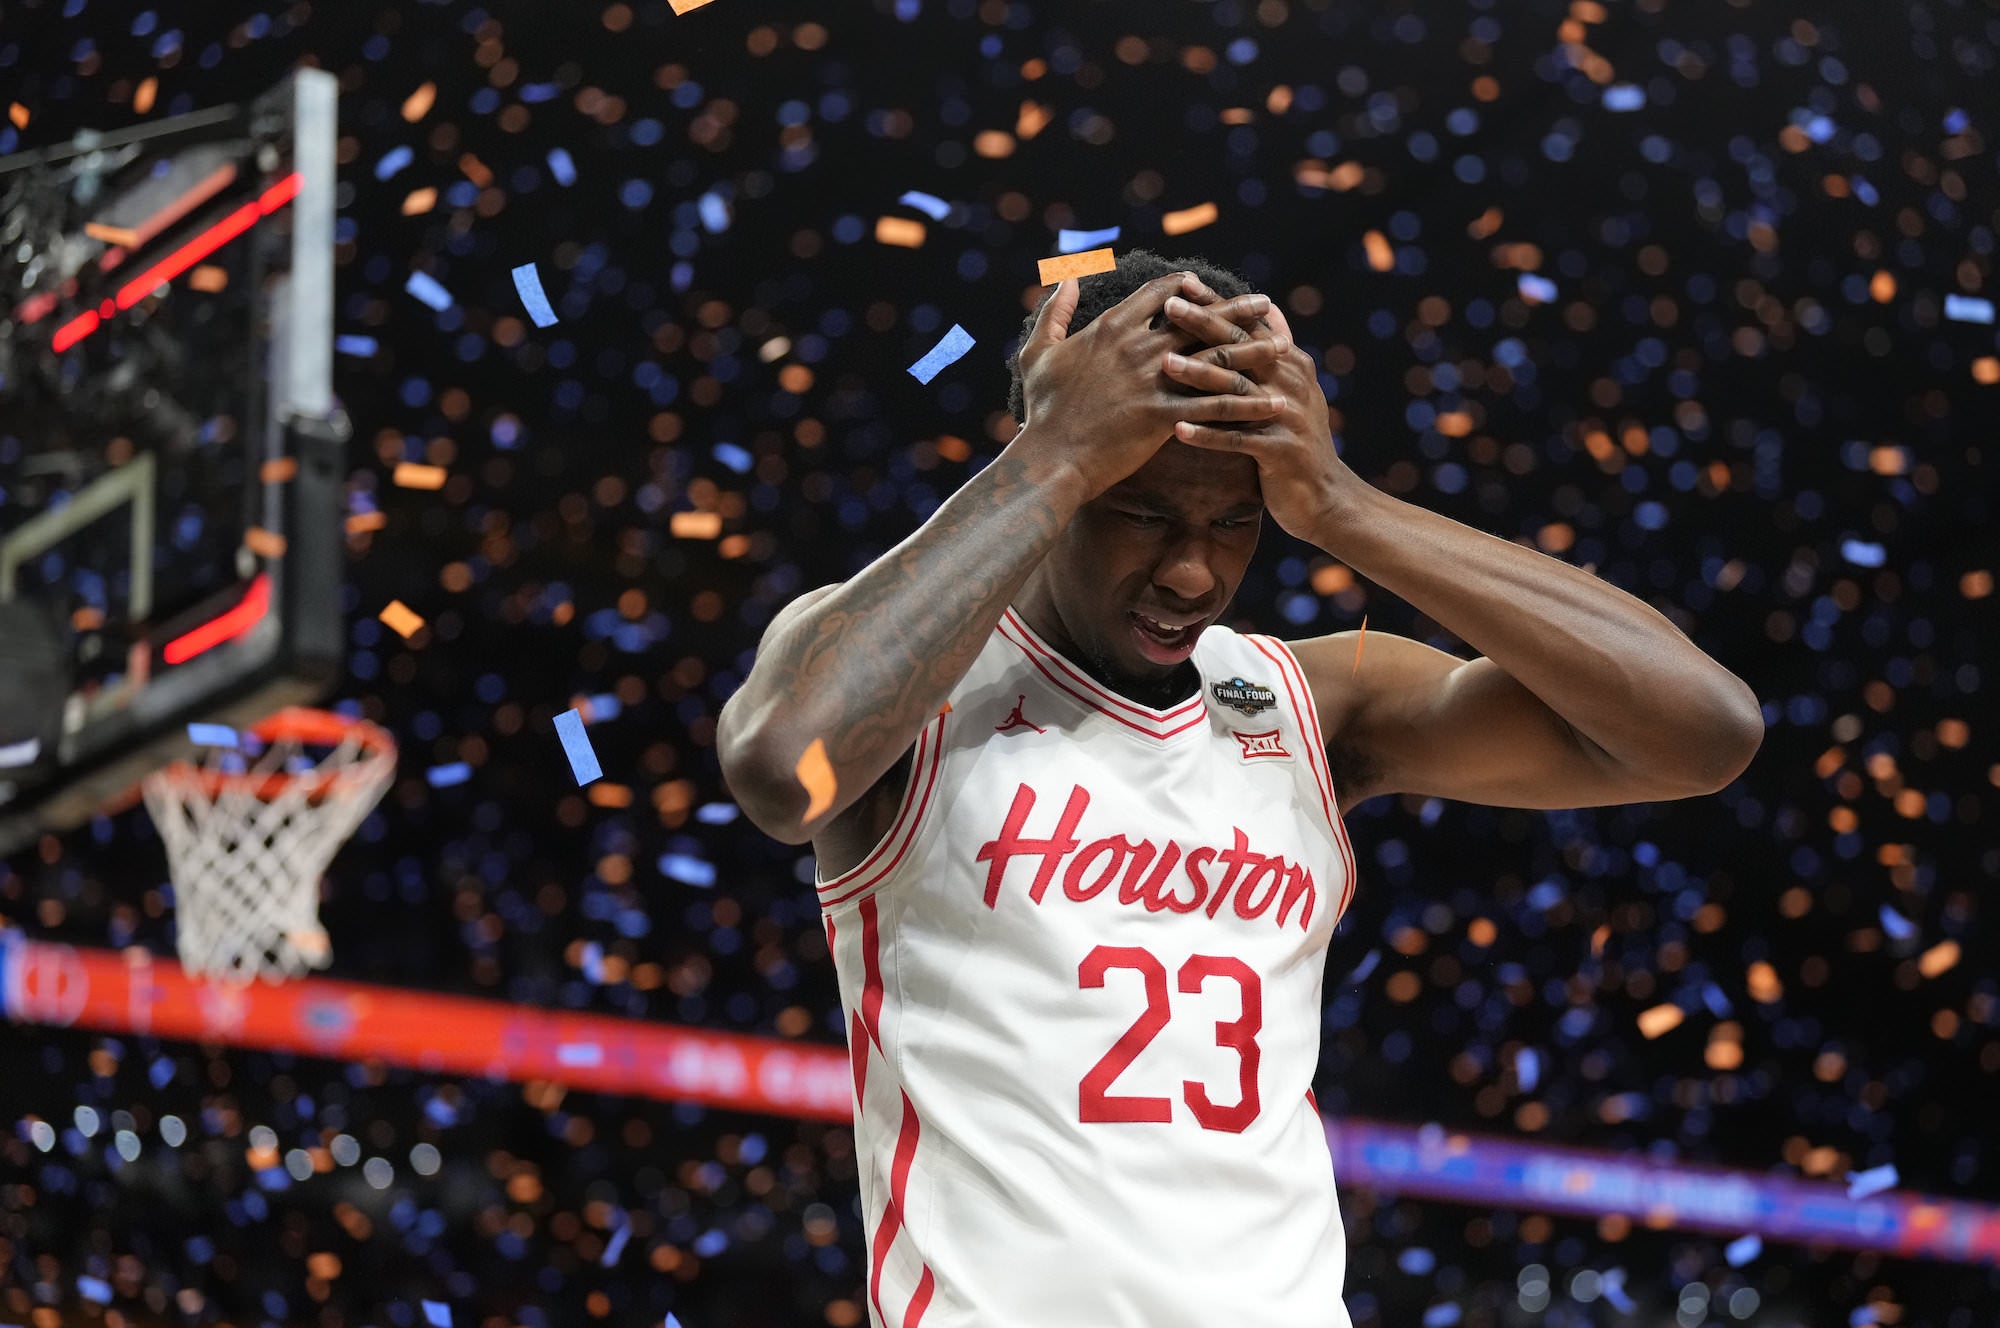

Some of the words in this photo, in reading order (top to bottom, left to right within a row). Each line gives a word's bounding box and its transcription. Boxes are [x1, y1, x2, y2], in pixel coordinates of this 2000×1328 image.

[1217, 688, 1245, 699] FINAL
[1246, 690, 1273, 700] FOUR
[976, 783, 1317, 932] Houston
[1077, 944, 1263, 1134] 23
